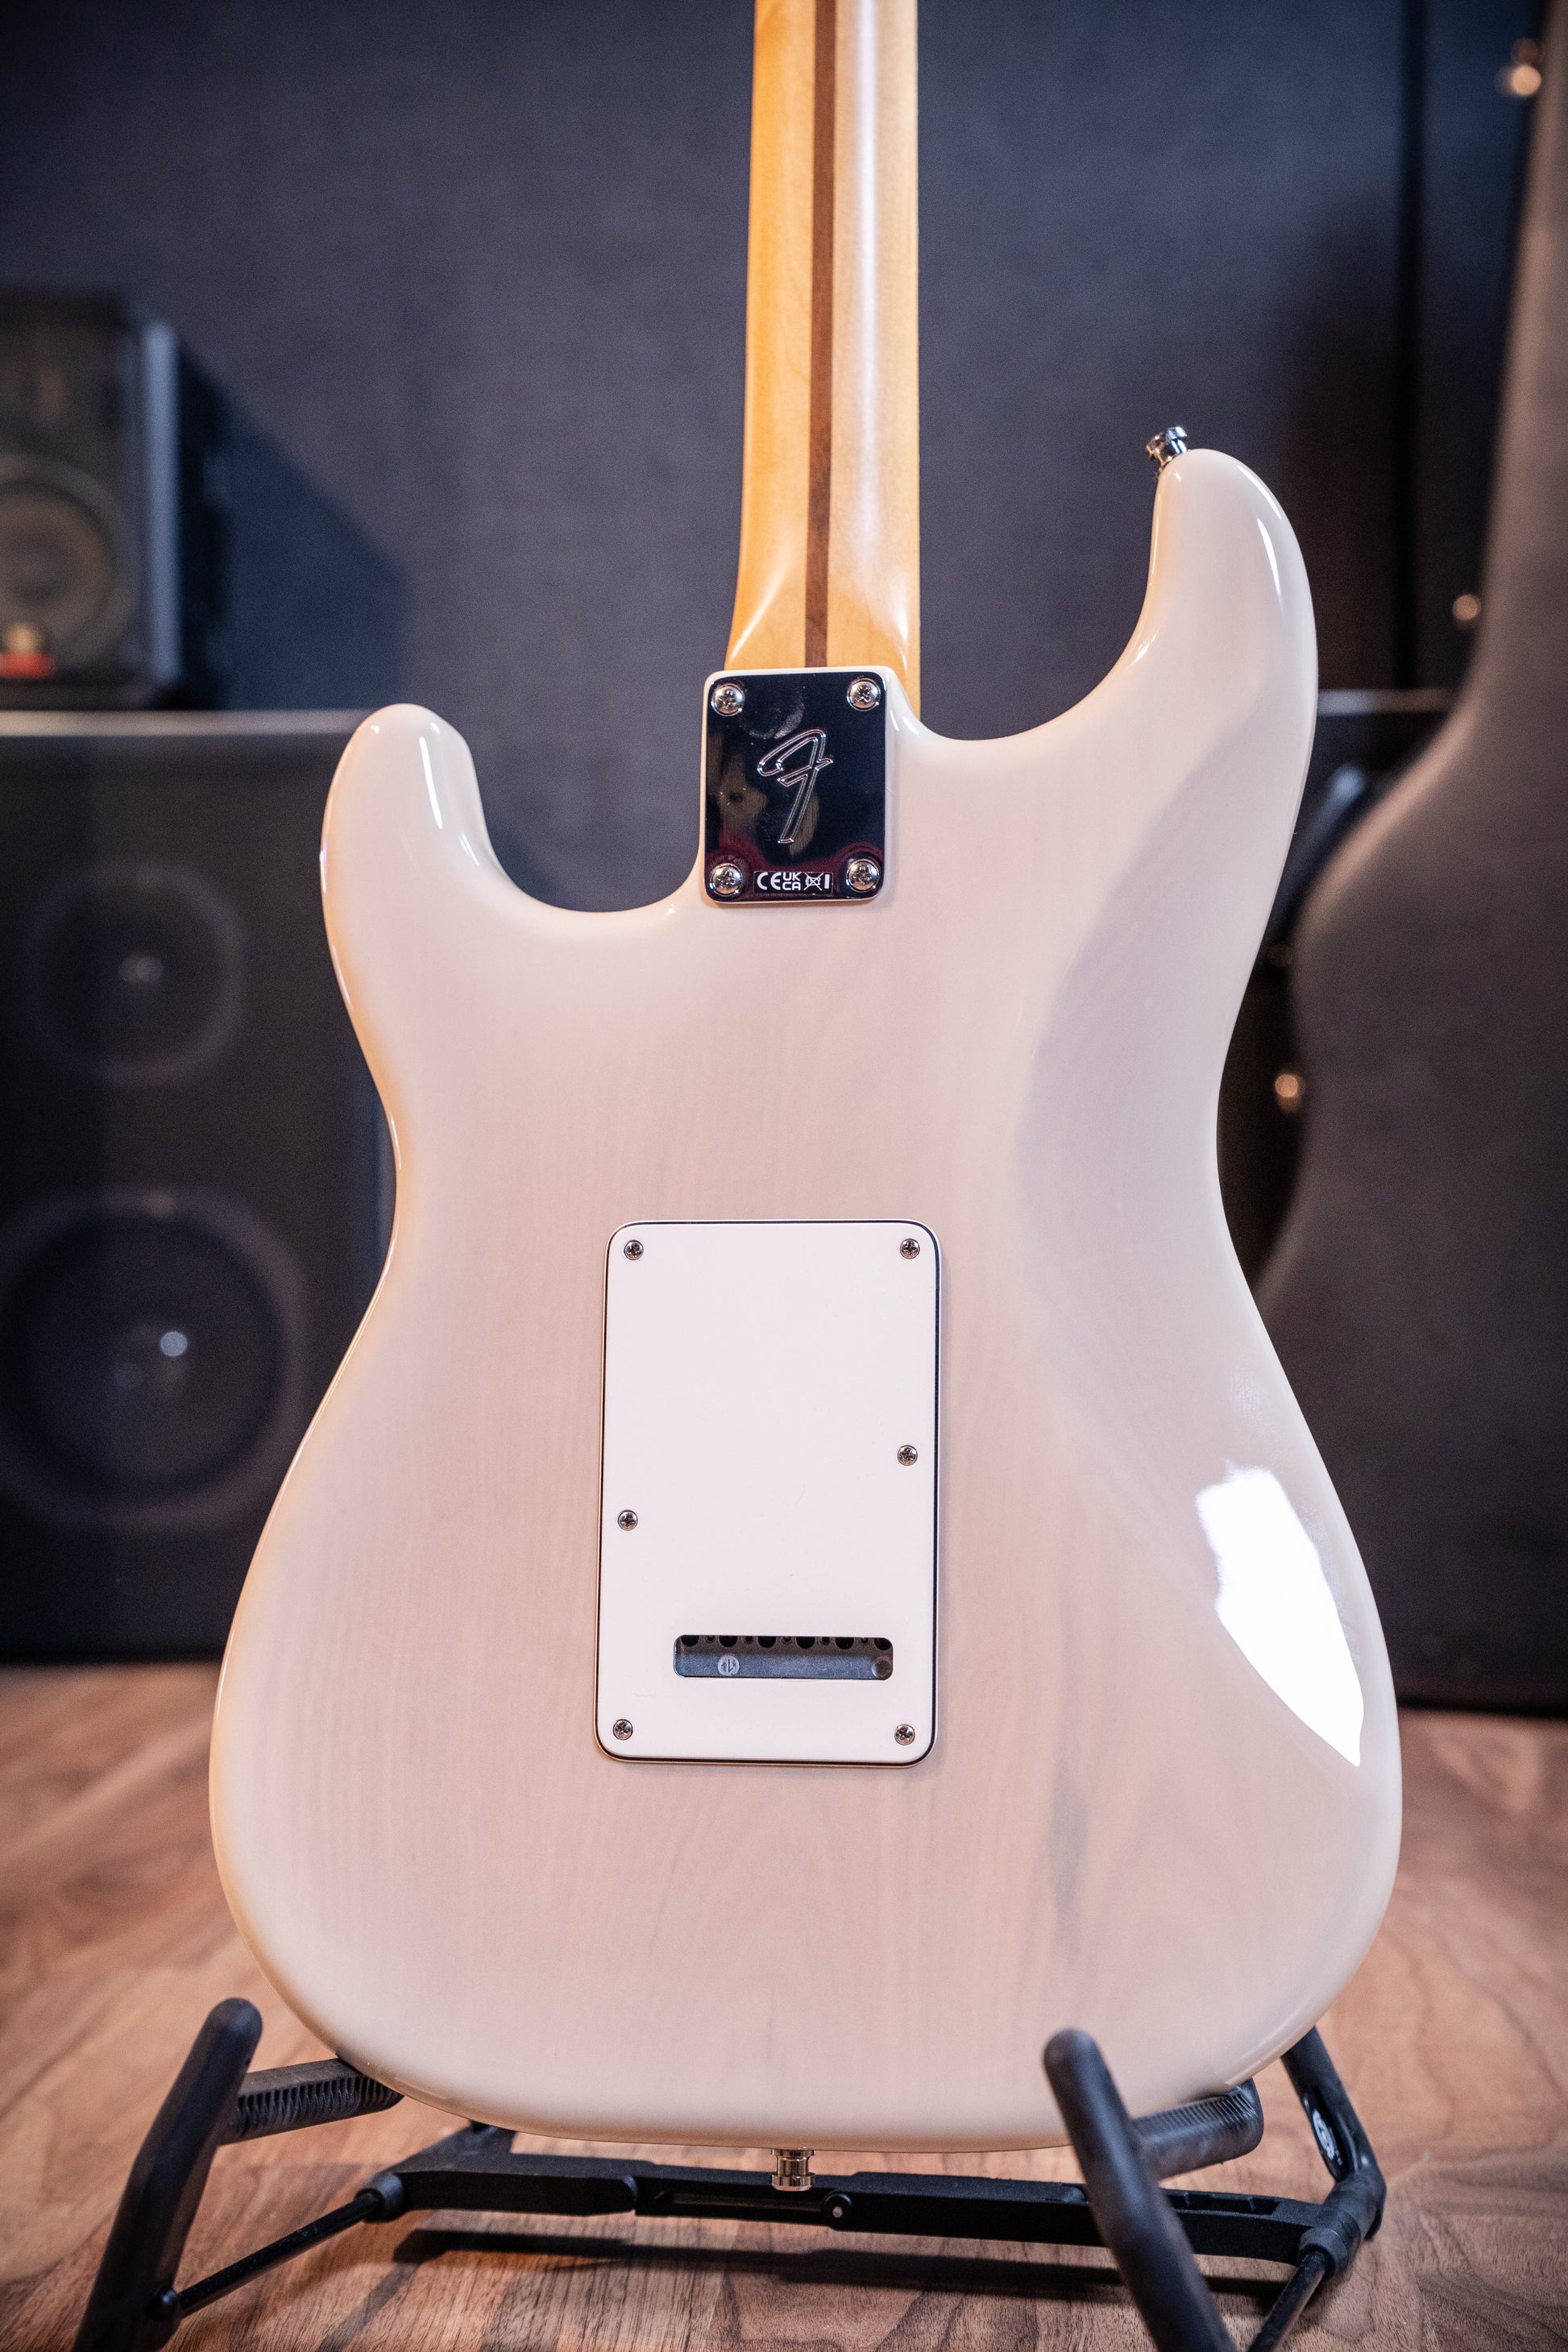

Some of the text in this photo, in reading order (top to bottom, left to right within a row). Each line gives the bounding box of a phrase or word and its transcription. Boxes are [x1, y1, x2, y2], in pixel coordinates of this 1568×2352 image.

[757, 872, 782, 890] CE
[782, 872, 802, 881] UK
[782, 881, 801, 890] CA
